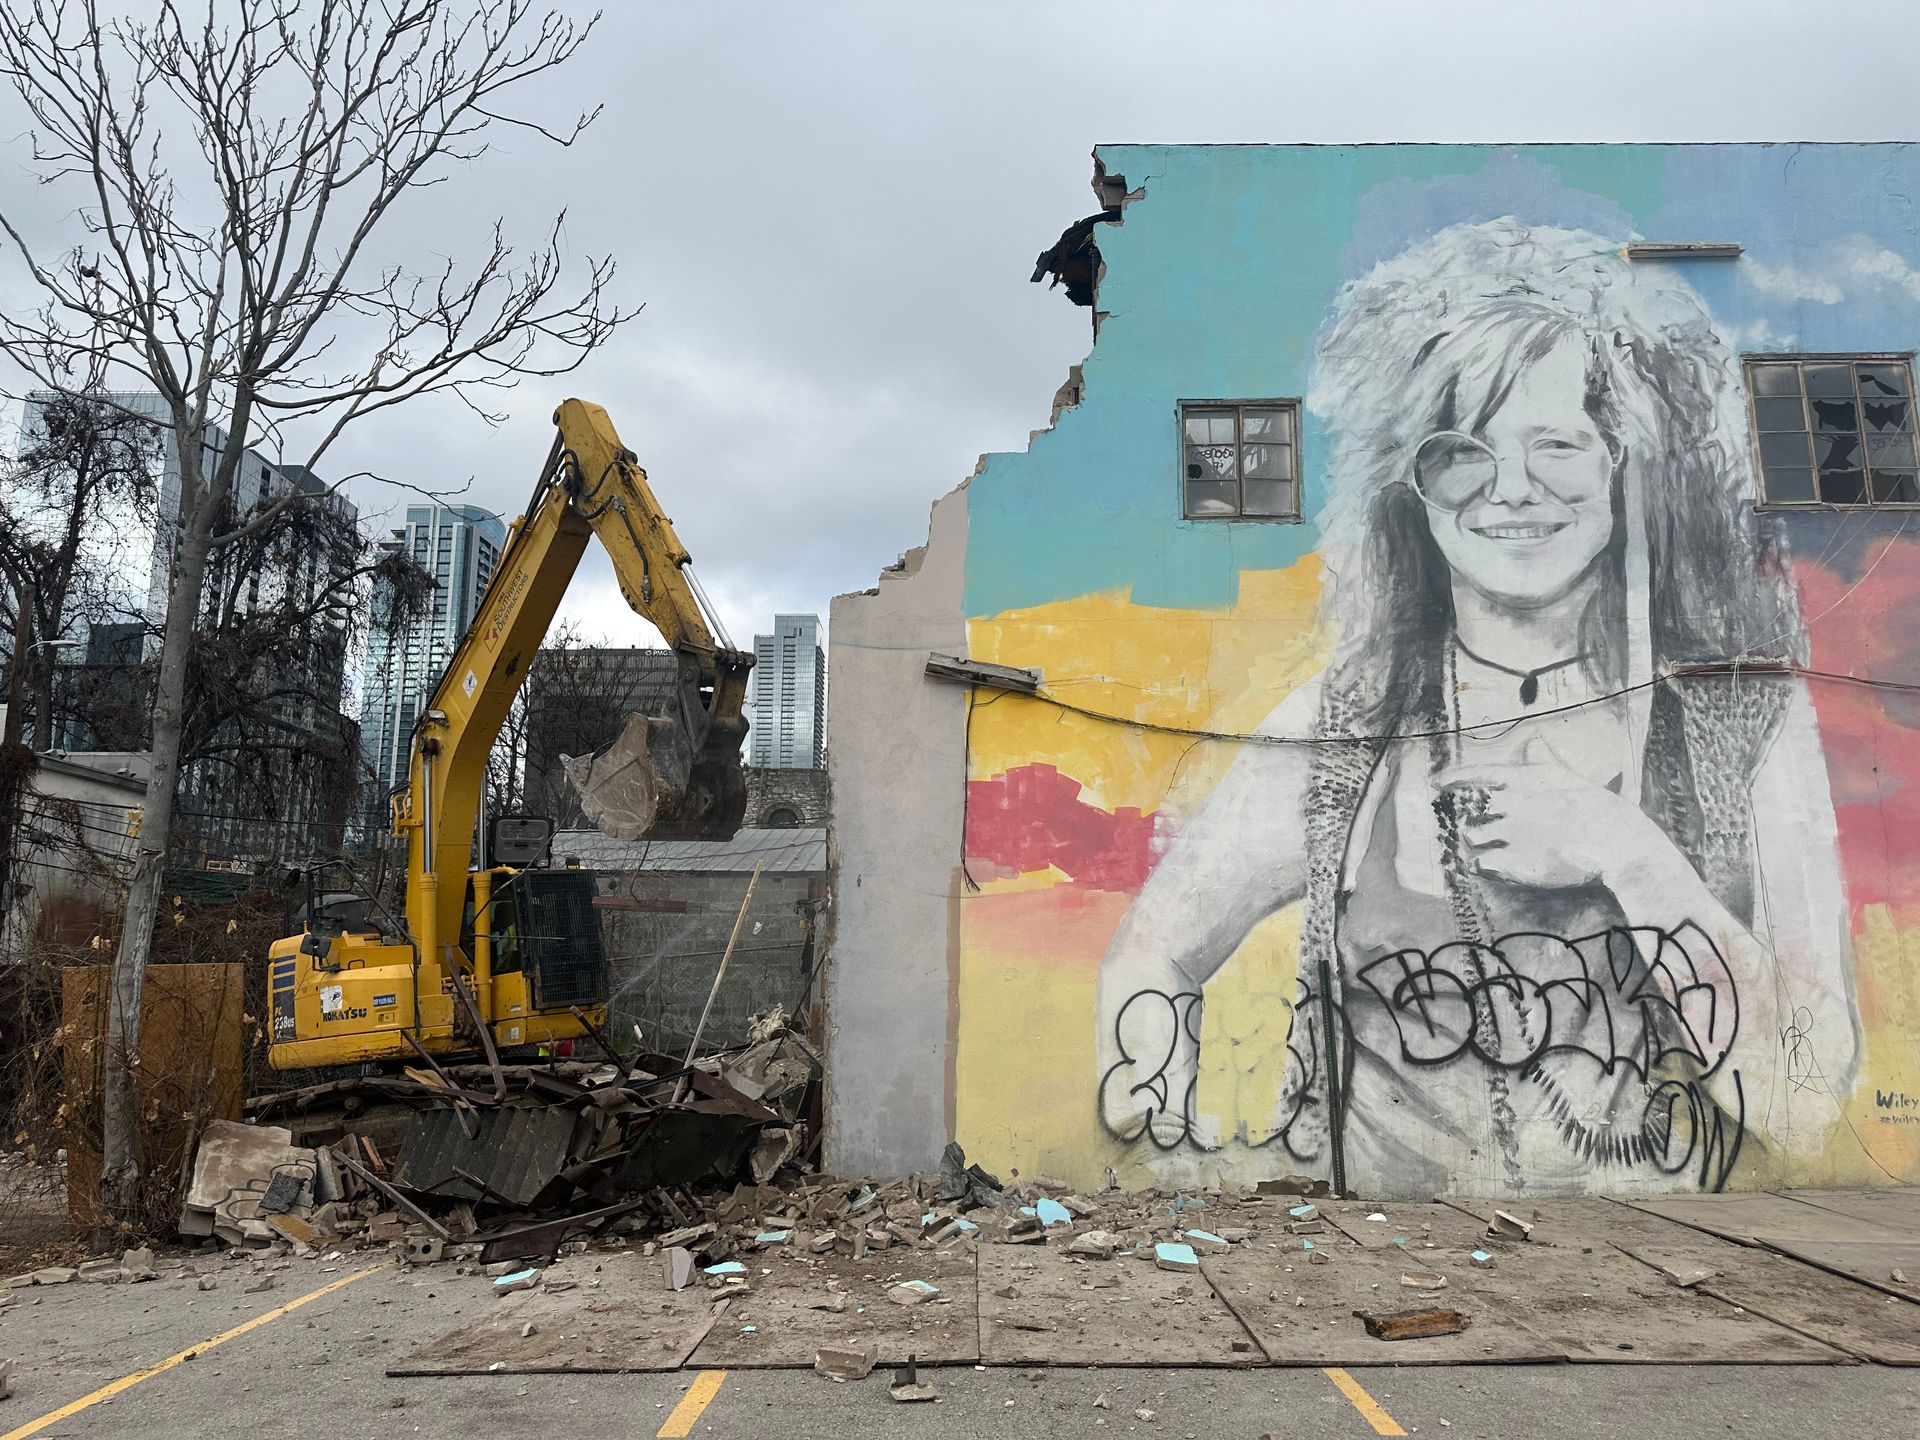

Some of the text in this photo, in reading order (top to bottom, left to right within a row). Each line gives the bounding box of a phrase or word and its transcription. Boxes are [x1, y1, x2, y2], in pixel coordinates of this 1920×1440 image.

[493, 569, 524, 624] SOUTHWEST
[497, 573, 529, 633] DESTRUCTORS
[323, 1007, 368, 1022] KOMATSU
[1876, 1089, 1919, 1110] Wiley
